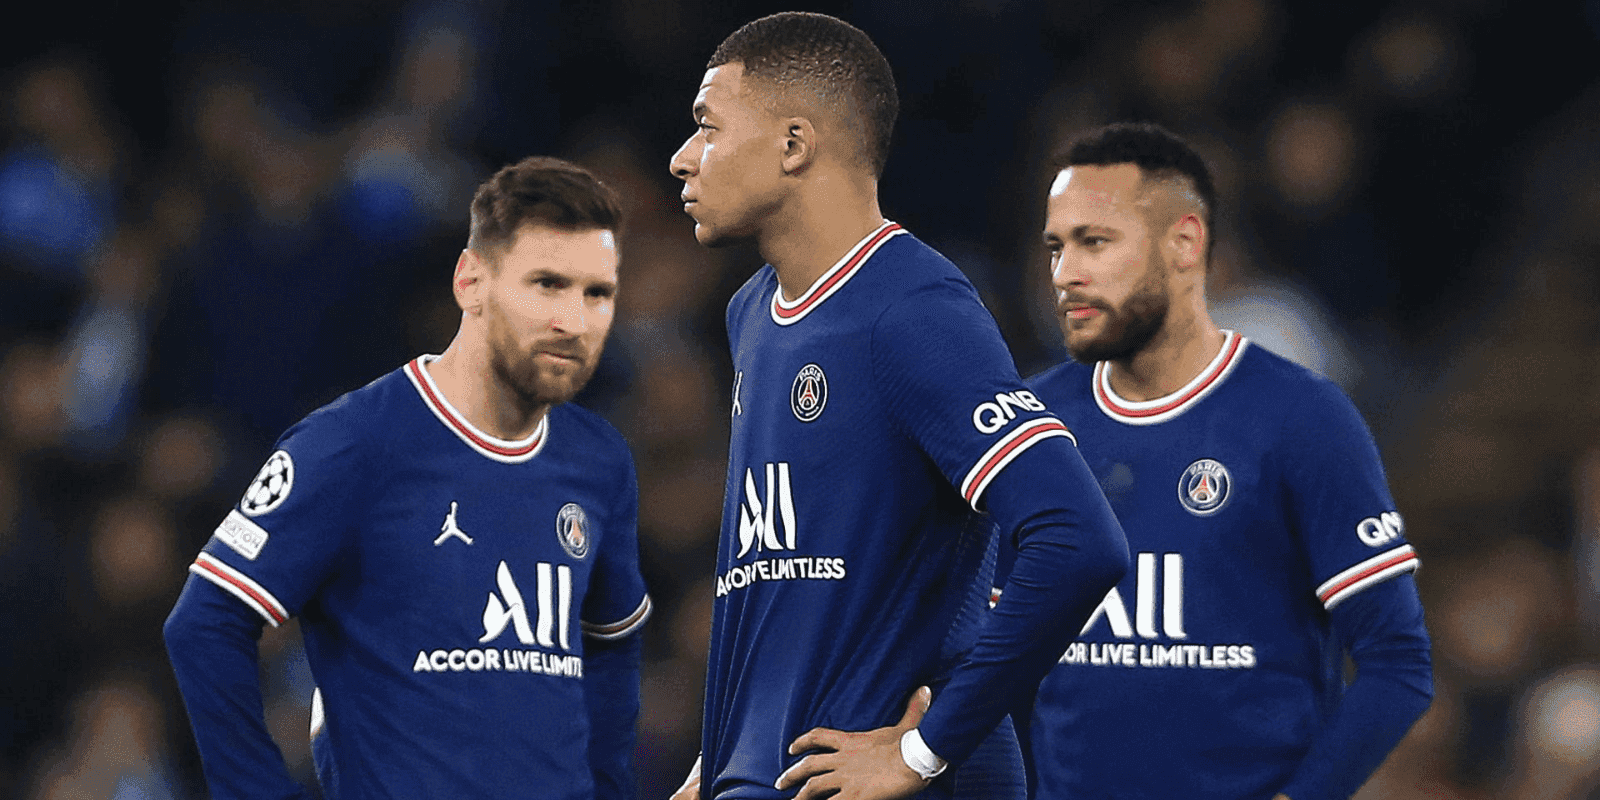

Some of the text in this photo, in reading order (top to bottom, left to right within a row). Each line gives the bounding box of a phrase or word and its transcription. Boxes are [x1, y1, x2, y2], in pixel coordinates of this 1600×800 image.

[799, 366, 821, 382] PARIS
[973, 390, 1046, 434] QNB
[1356, 511, 1403, 547] QN
[413, 648, 583, 678] ACCOR LIVE LIMIT
[1090, 643, 1137, 667] LIVE
[1139, 644, 1257, 669] LIMITLESS
